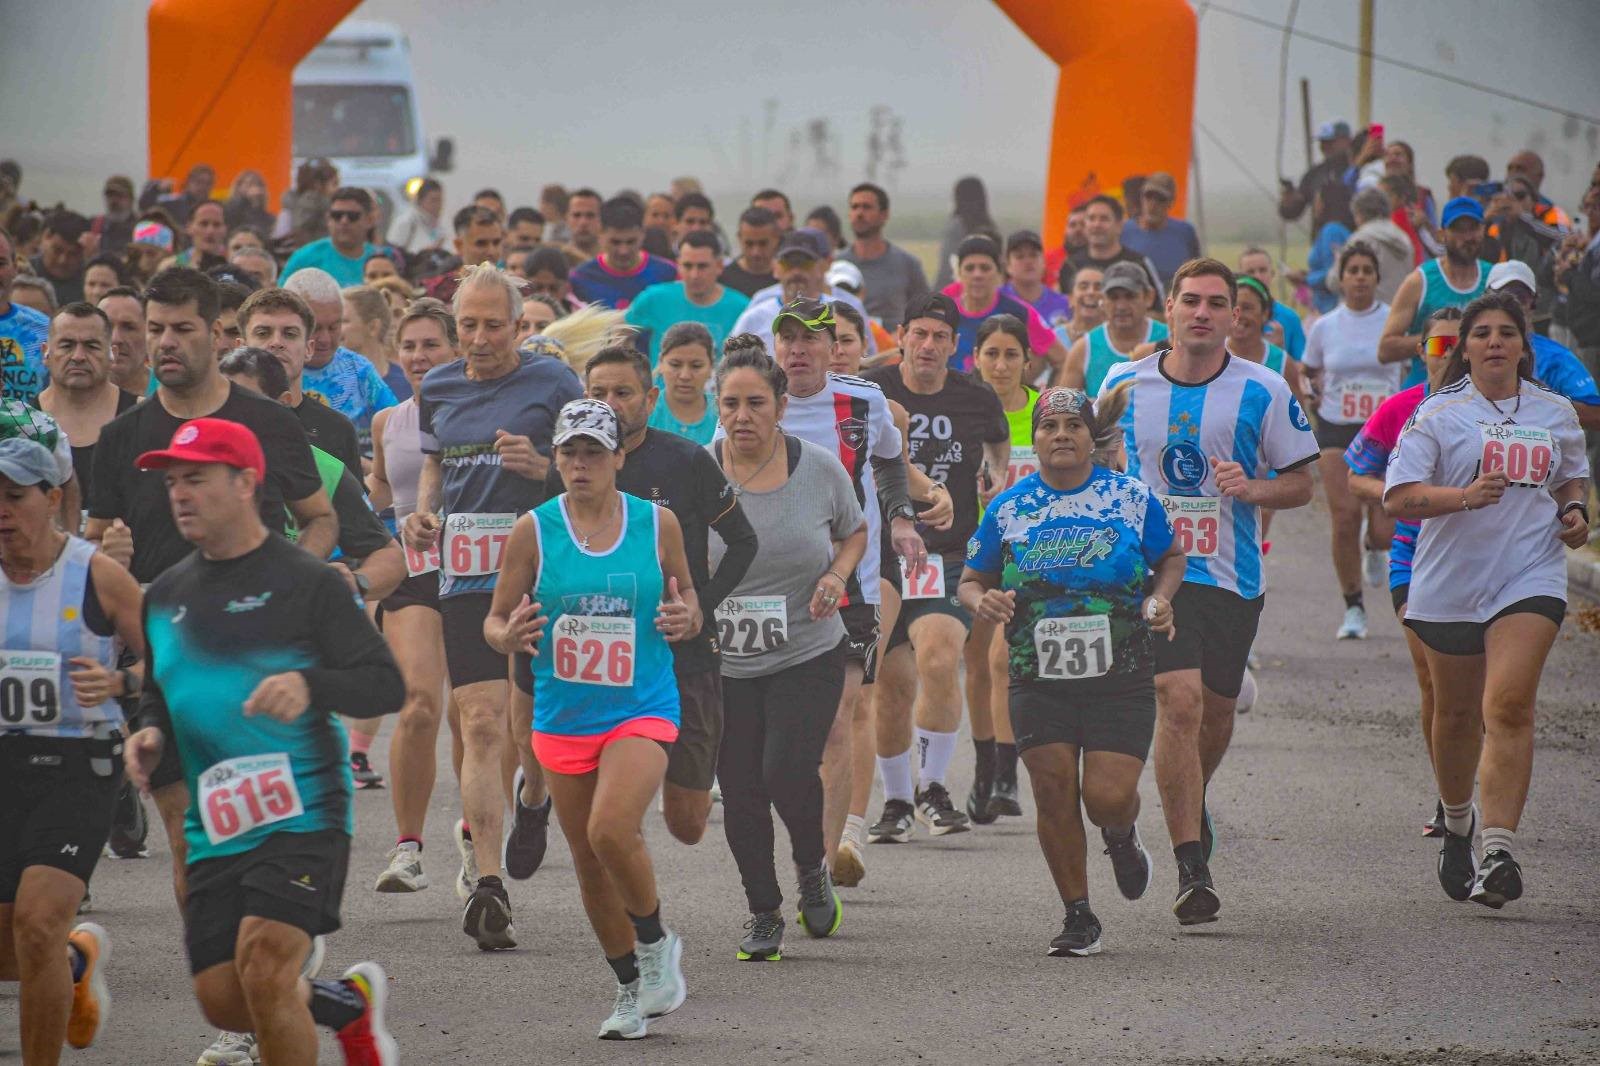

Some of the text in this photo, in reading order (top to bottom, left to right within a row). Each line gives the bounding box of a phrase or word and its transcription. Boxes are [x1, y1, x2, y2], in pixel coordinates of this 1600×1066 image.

[910, 413, 953, 440] 20
[1514, 429, 1549, 438] RUFF
[1482, 440, 1551, 482] 609
[1180, 501, 1217, 509] RUFF
[475, 518, 514, 526] RUFF
[1033, 526, 1094, 551] RING
[451, 534, 510, 573] 617
[744, 601, 782, 609] RUFF
[590, 622, 632, 631] RUFF
[718, 617, 784, 653] 226
[1068, 620, 1106, 630] RUFF
[556, 637, 632, 684] 626
[1041, 636, 1107, 676] 231
[0, 676, 57, 723] 09
[207, 768, 294, 837] 615
